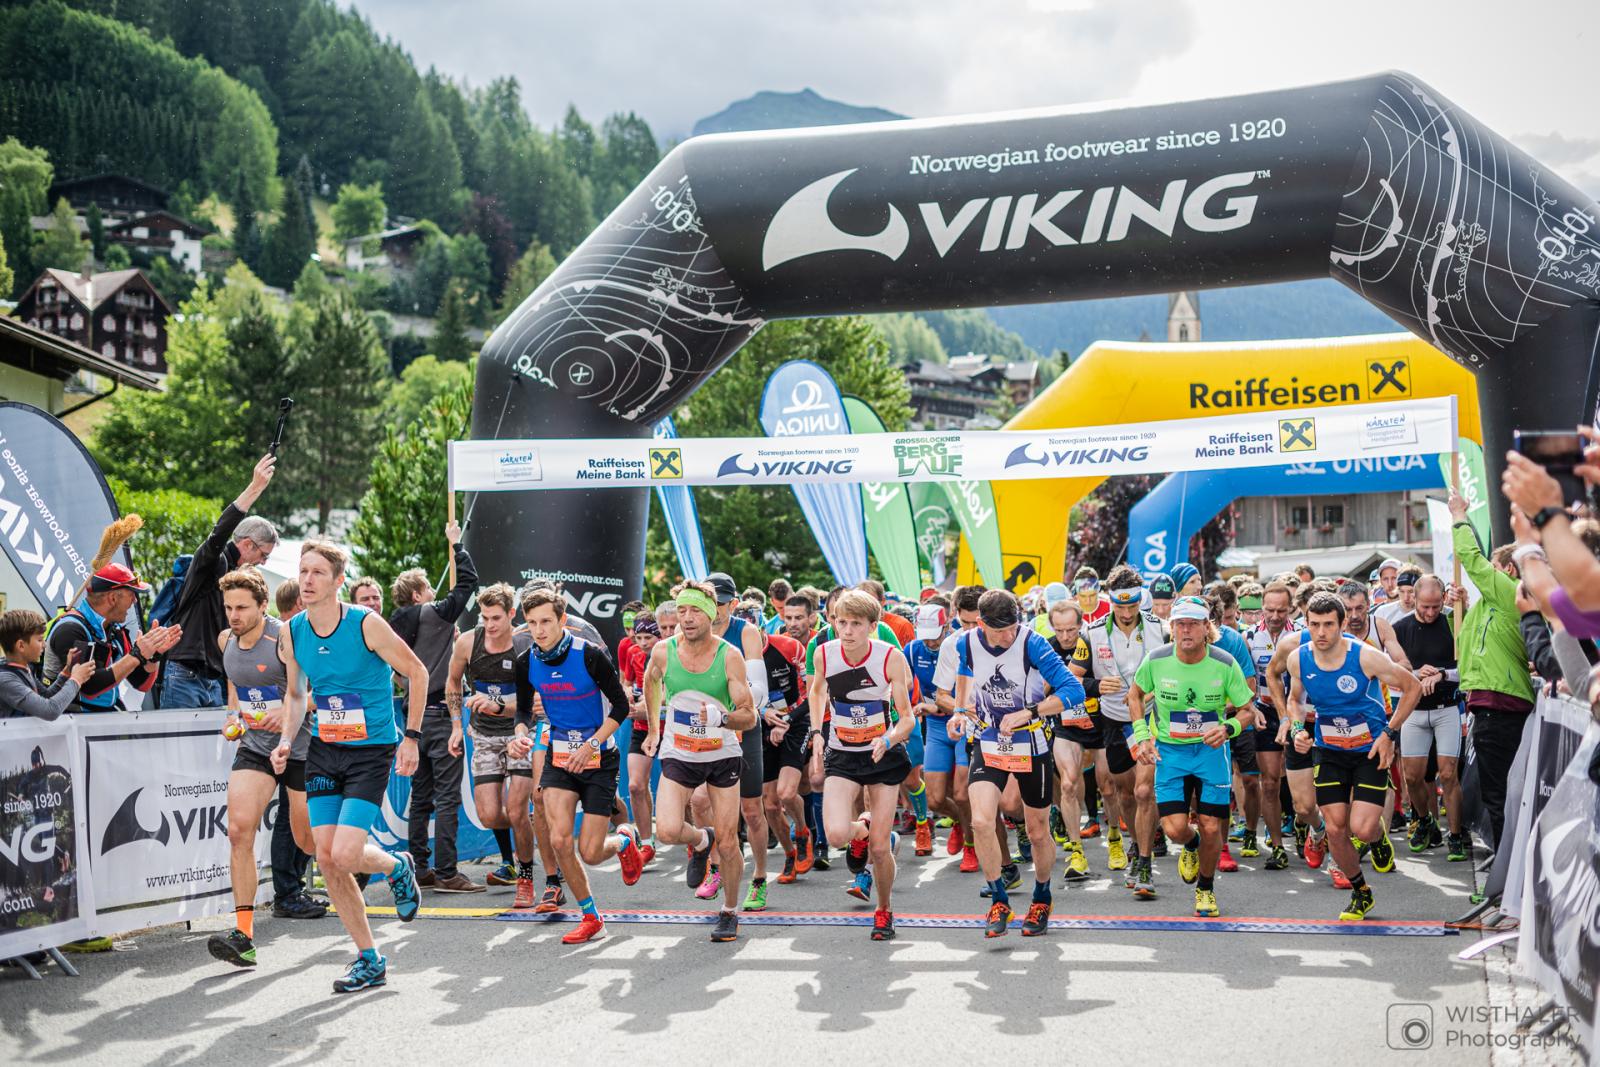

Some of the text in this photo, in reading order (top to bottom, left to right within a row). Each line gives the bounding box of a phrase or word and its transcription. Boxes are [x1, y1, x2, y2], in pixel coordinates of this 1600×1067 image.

[909, 117, 1287, 175] Norwegian footwear since 1920
[918, 171, 1259, 259] VIKING
[1189, 377, 1361, 410] Raiffeisen
[895, 436, 961, 444] GROSSGLOCKNER
[1120, 433, 1138, 441] since
[1140, 432, 1156, 440] 1920
[1209, 432, 1273, 445] Raiffeisen
[758, 449, 794, 457] Norwegian
[893, 442, 948, 458] BERG
[1053, 446, 1149, 466] VIKING
[1195, 444, 1274, 458] Meine Bank
[588, 458, 645, 468] Raiffeisen
[762, 460, 853, 477] VIKING
[576, 468, 645, 480] Meine Bank
[520, 569, 624, 587] vikingfootwear.com
[992, 692, 1011, 700] TRC
[250, 702, 267, 710] 340
[330, 711, 346, 720] 537
[851, 717, 868, 725] 385
[689, 727, 706, 735] 348
[1336, 727, 1352, 735] 319
[997, 744, 1014, 752] 285
[164, 782, 211, 798] Norwegian
[4, 792, 62, 814] since 1920
[0, 896, 35, 914] .com
